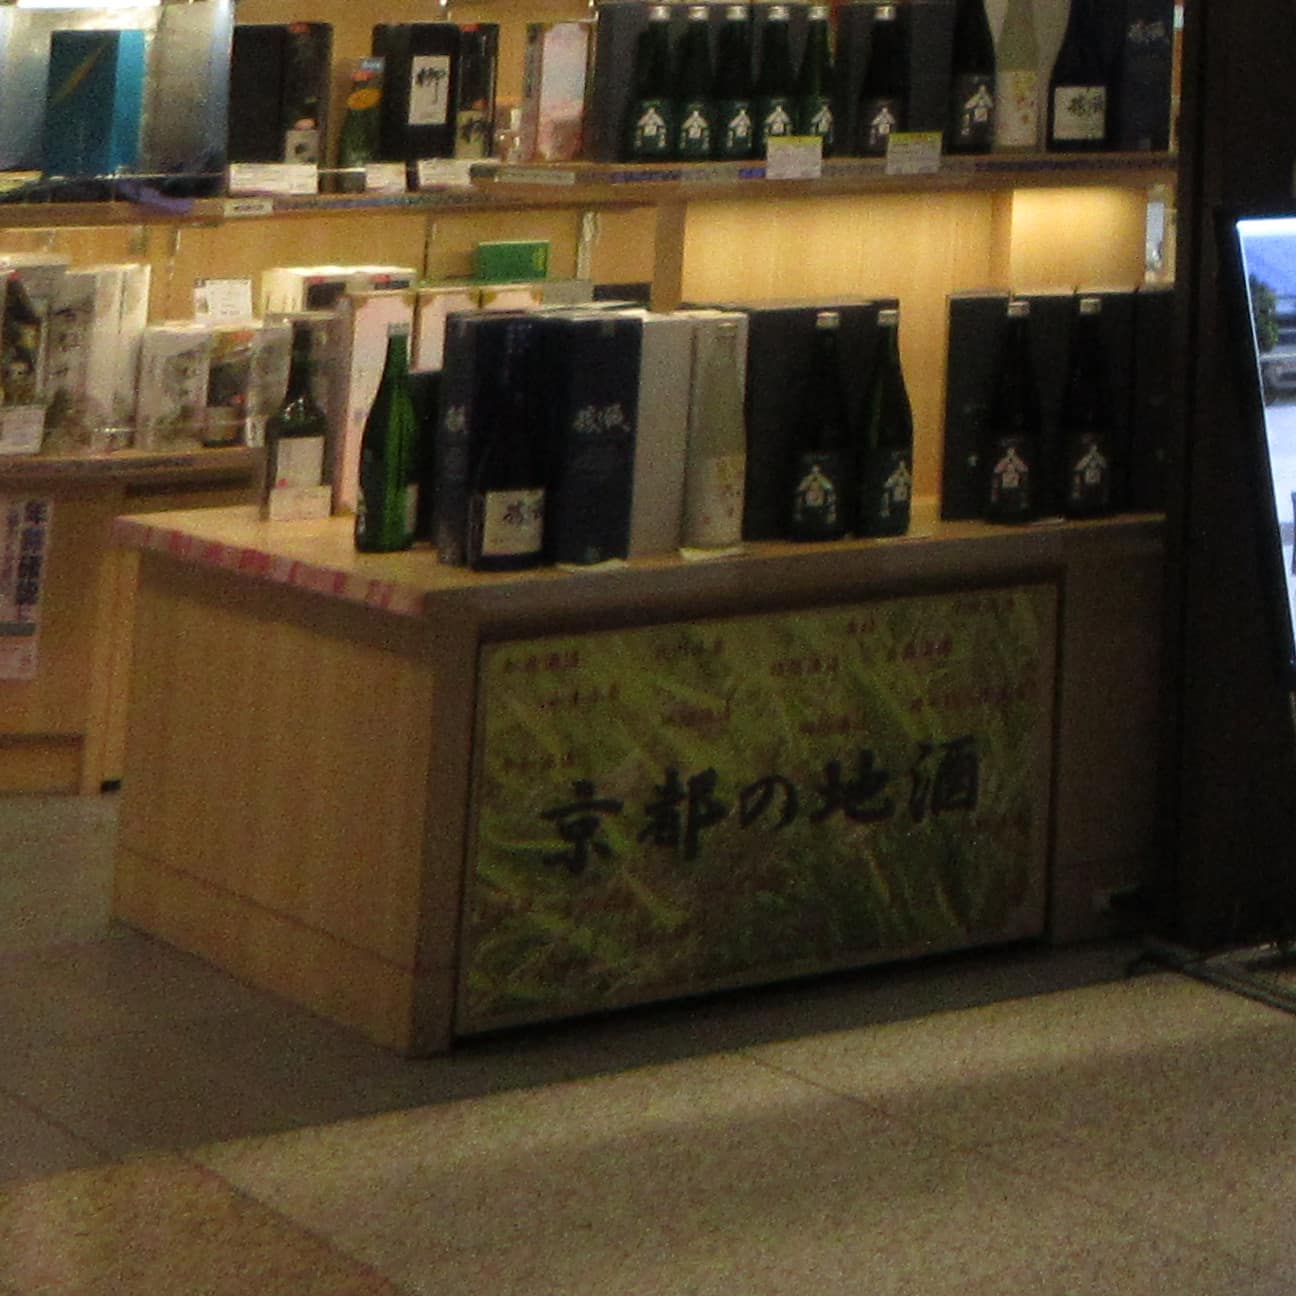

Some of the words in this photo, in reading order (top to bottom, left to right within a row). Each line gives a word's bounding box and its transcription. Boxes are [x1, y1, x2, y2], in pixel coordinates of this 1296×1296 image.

[539, 735, 979, 874] 京都の地酒
